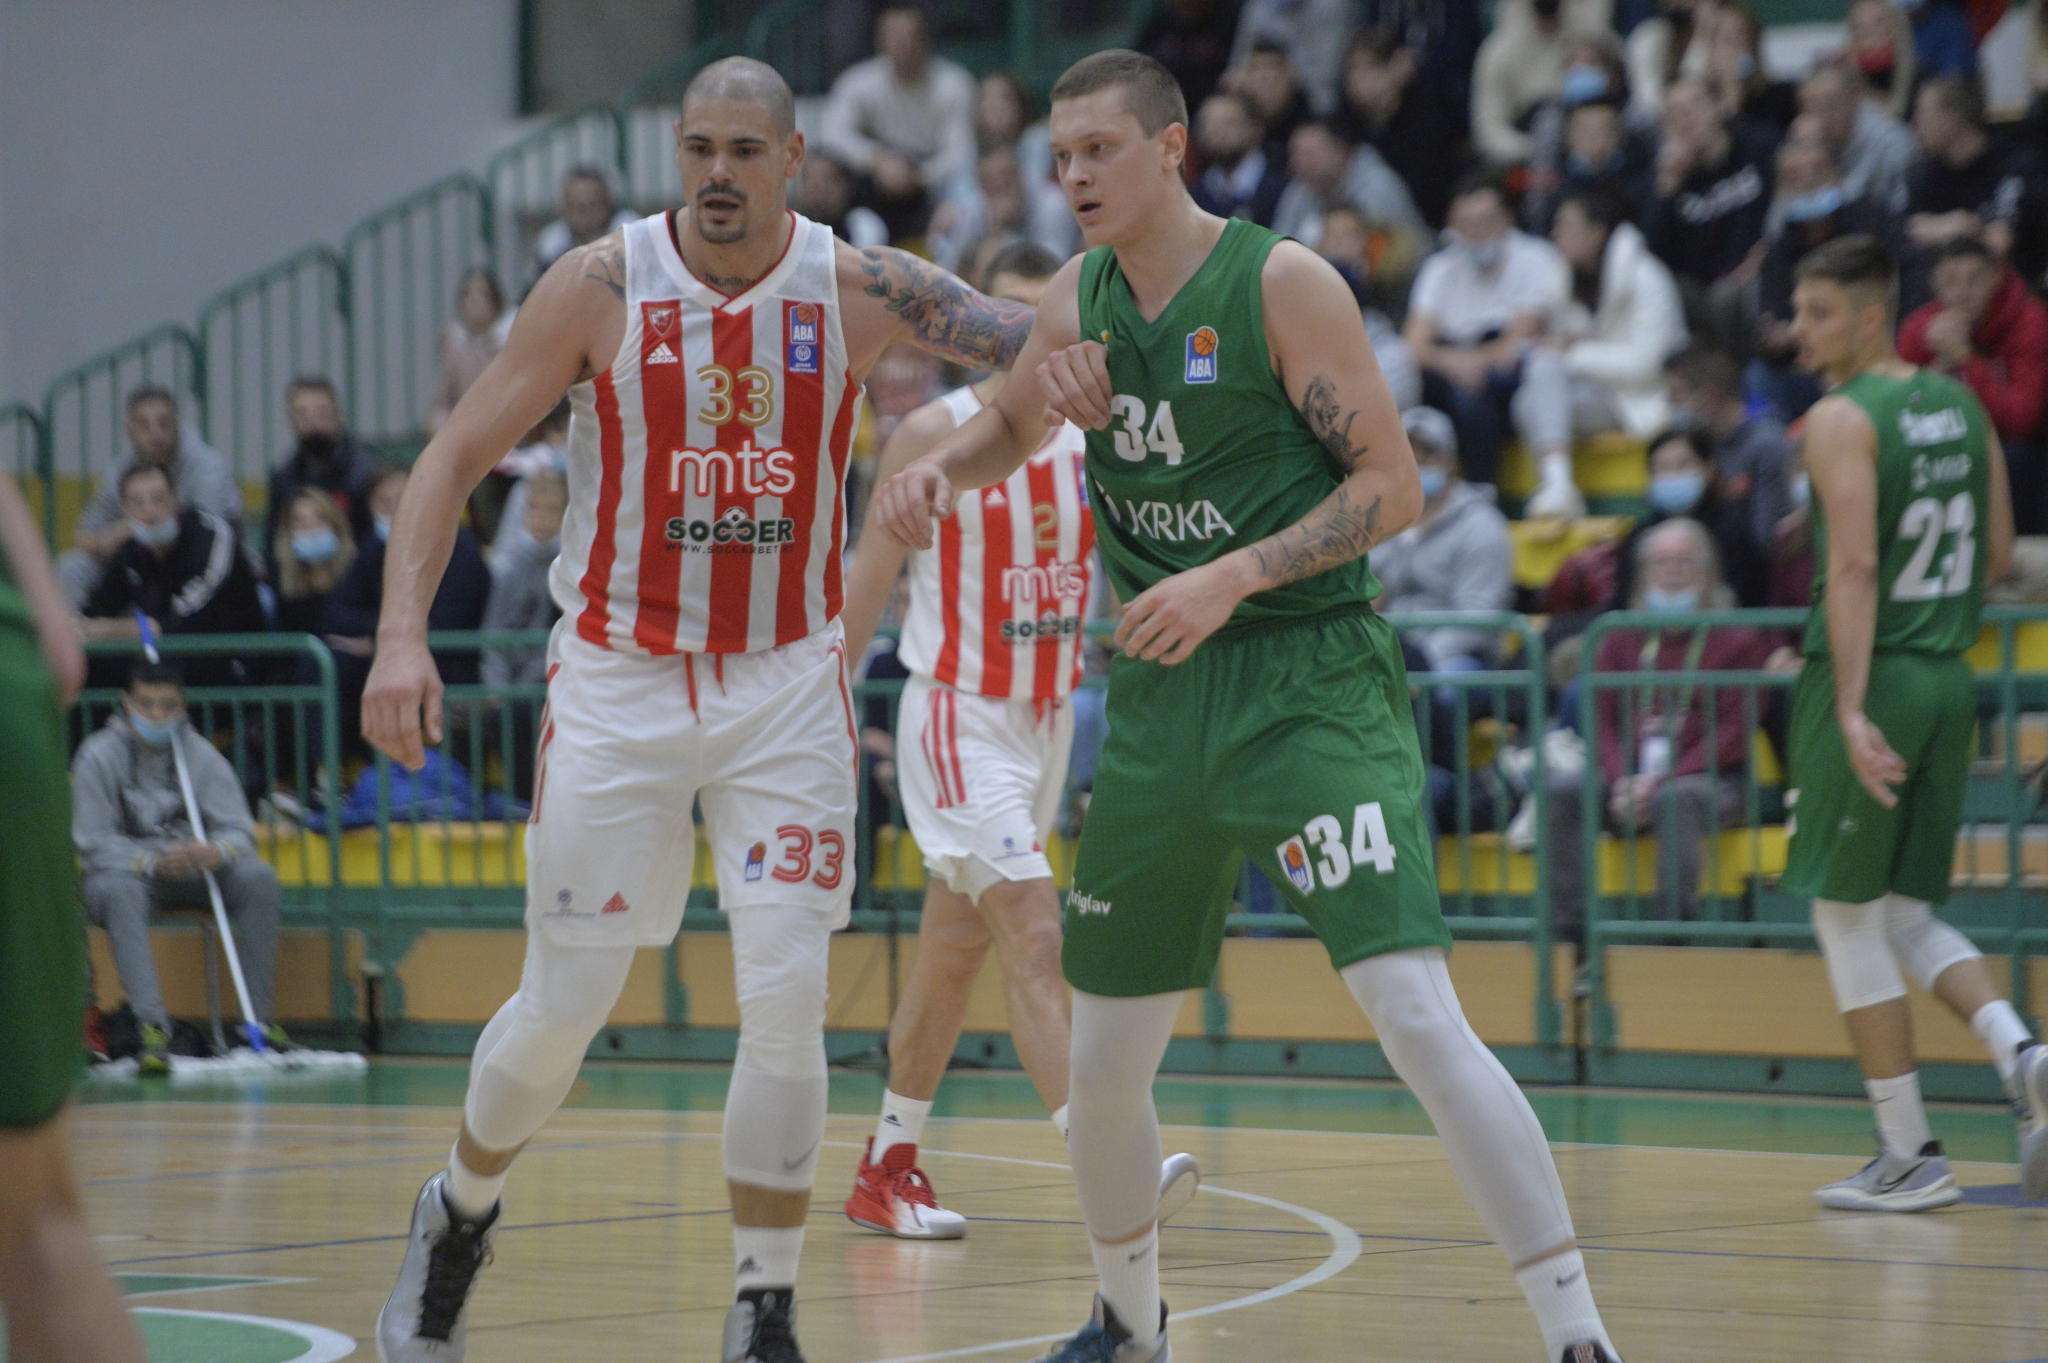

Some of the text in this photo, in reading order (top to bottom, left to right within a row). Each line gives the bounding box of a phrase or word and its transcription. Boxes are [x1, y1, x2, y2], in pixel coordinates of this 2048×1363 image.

[792, 325, 814, 341] ABA
[647, 355, 679, 365] adidas
[1188, 358, 1213, 379] ABA
[696, 364, 775, 427] 33
[1110, 394, 1185, 466] 34
[670, 439, 797, 495] mts
[665, 516, 796, 543] SOCCER
[1034, 503, 1058, 550] 2
[1125, 499, 1237, 542] KRKA
[1889, 491, 1976, 602] 23
[1001, 557, 1086, 602] mts
[771, 824, 846, 890] 33
[1303, 801, 1398, 890] 34
